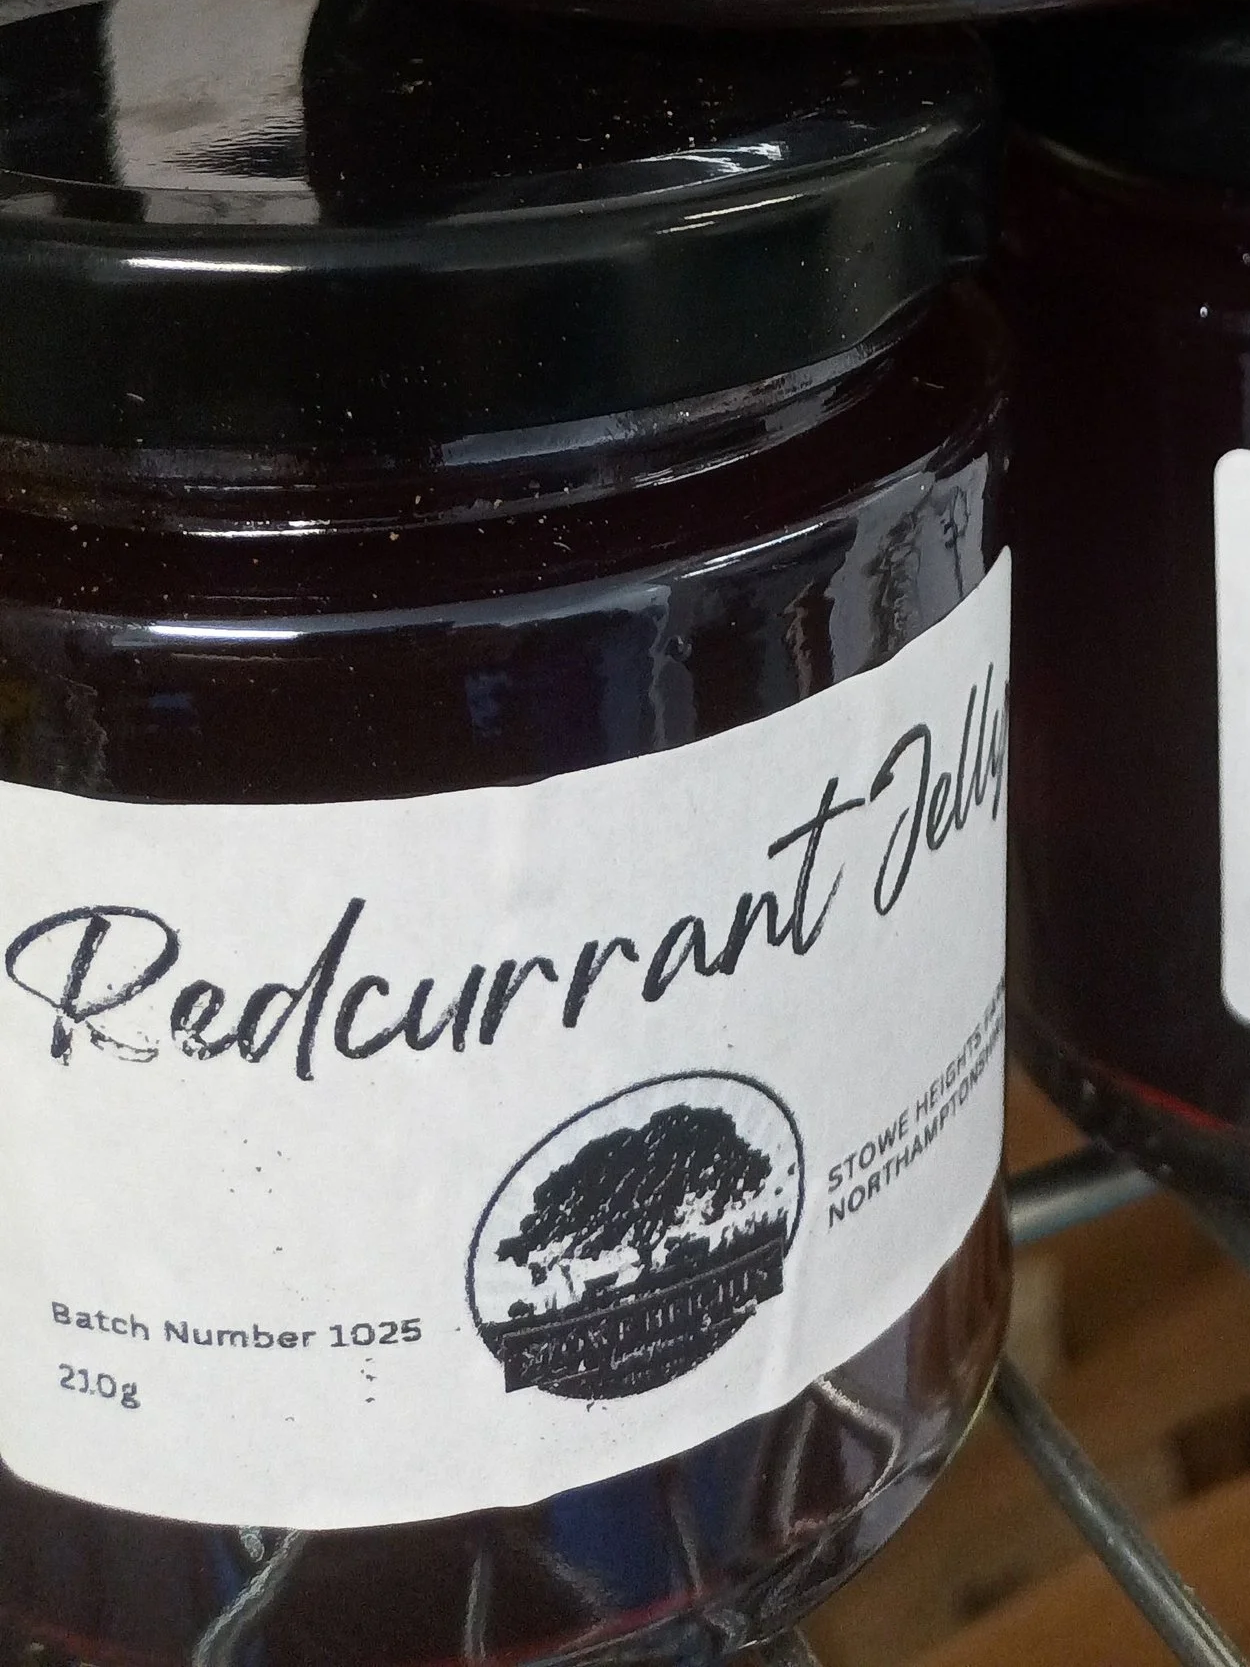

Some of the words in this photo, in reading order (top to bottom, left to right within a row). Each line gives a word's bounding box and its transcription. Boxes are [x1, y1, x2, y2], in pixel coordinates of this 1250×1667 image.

[4, 775, 866, 1081] Redcurrant
[869, 661, 1009, 916] Jelly
[827, 1108, 910, 1194] STOWE
[915, 1021, 982, 1123] HEIGHTS
[51, 1300, 151, 1342] Batch
[163, 1319, 318, 1350] Number
[328, 1316, 423, 1349] 1025
[58, 1362, 142, 1411] 210g
